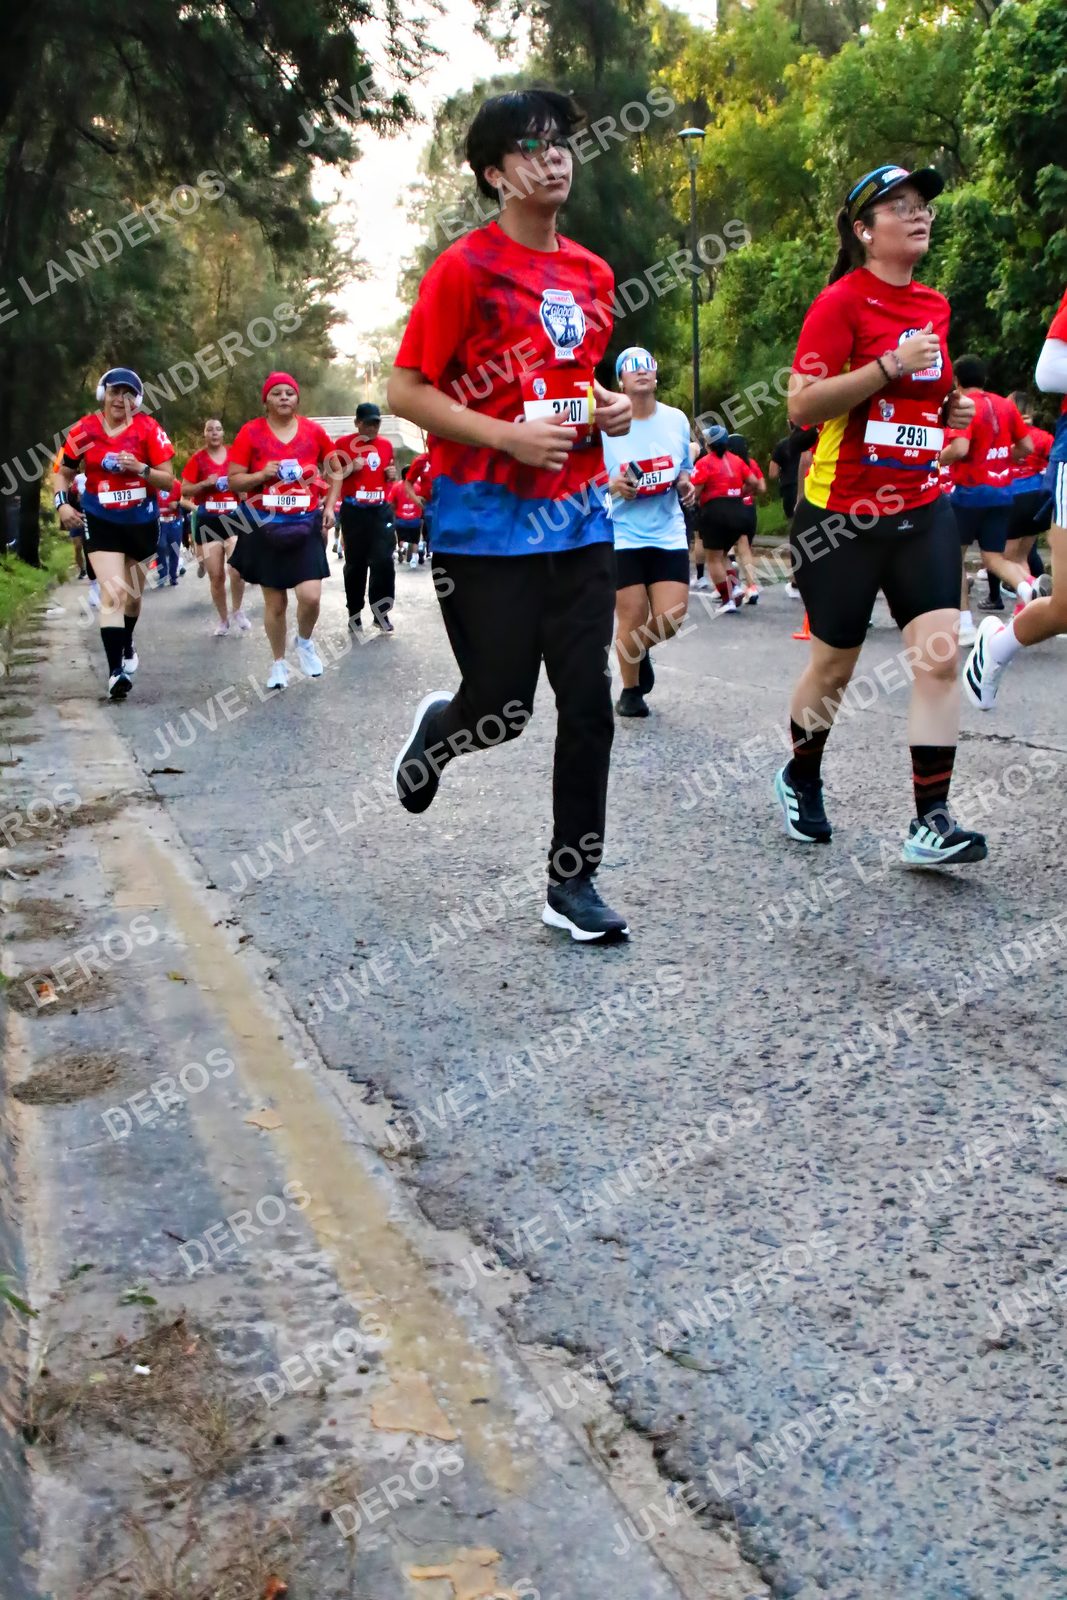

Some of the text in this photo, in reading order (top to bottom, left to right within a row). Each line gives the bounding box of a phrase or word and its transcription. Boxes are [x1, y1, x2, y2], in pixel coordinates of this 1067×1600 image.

[895, 425, 928, 448] 2931
[112, 490, 133, 502] 1373
[277, 496, 298, 507] 1909
